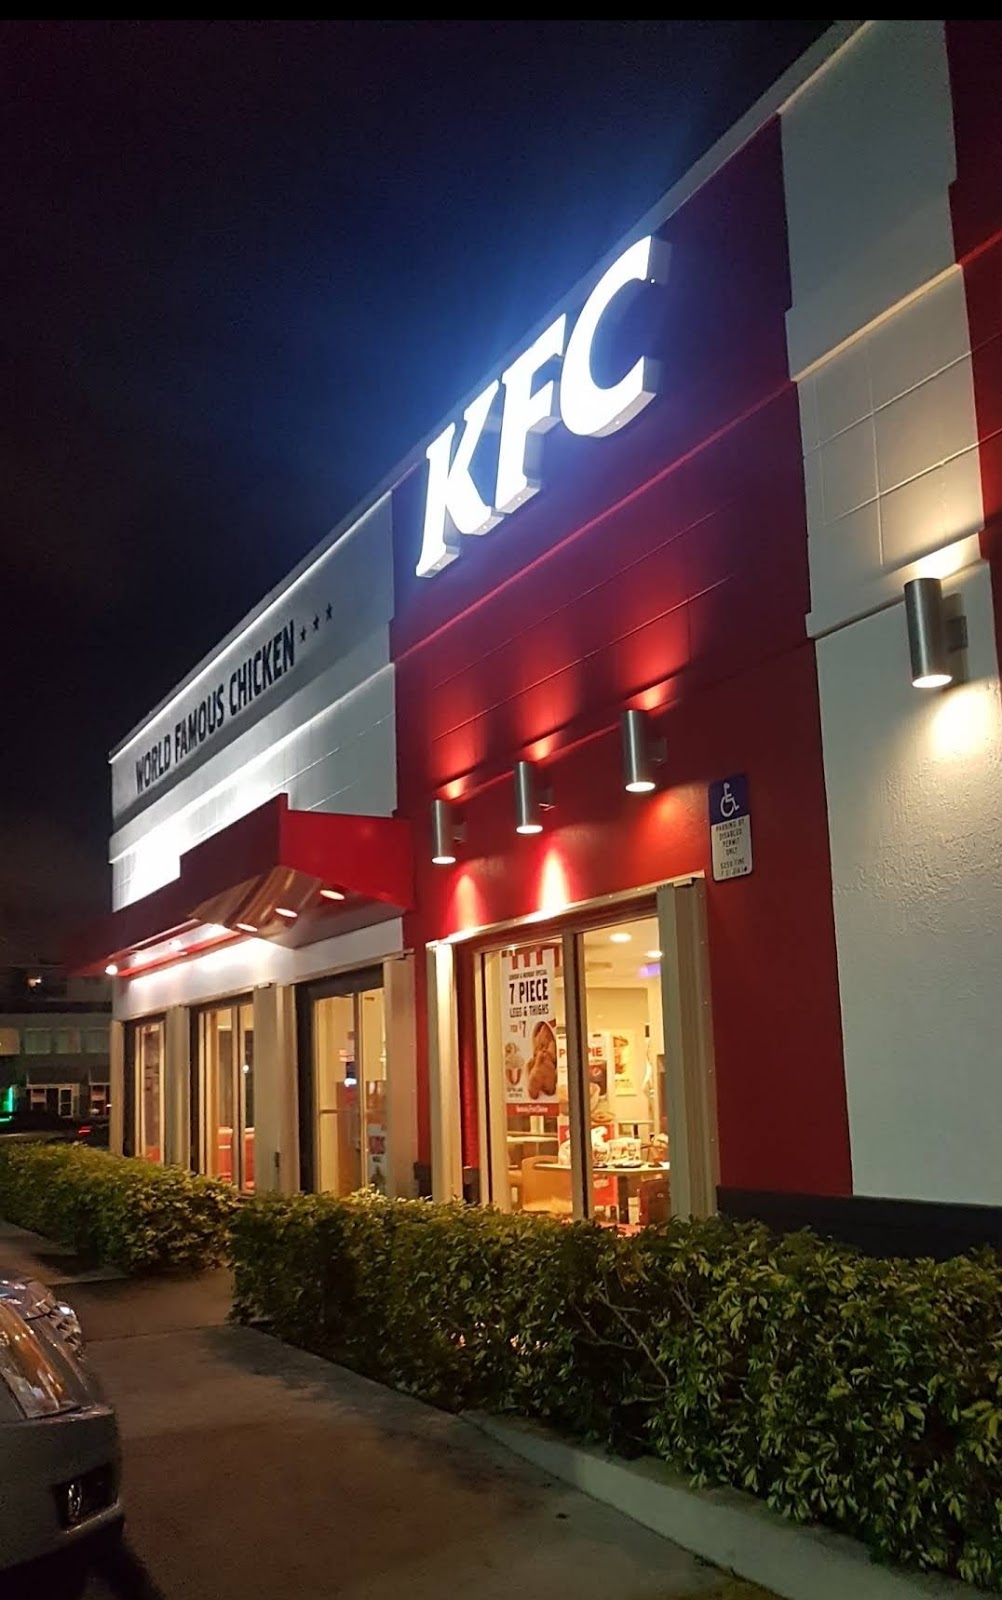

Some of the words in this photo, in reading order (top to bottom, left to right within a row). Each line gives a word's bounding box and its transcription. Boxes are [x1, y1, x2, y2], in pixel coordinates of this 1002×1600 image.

[415, 235, 653, 578] KFC
[135, 734, 171, 794] WORLD
[174, 683, 224, 763] FAMOUS
[228, 619, 295, 716] CHICKEN
[719, 828, 742, 841] DISABLED
[722, 837, 740, 848] PERMIT
[726, 847, 738, 856] ONLY
[509, 983, 515, 1004] 7
[519, 978, 548, 1003] PIECE
[510, 1007, 522, 1018] LEGS
[524, 1006, 528, 1017] &
[529, 1003, 549, 1016] THIGHS
